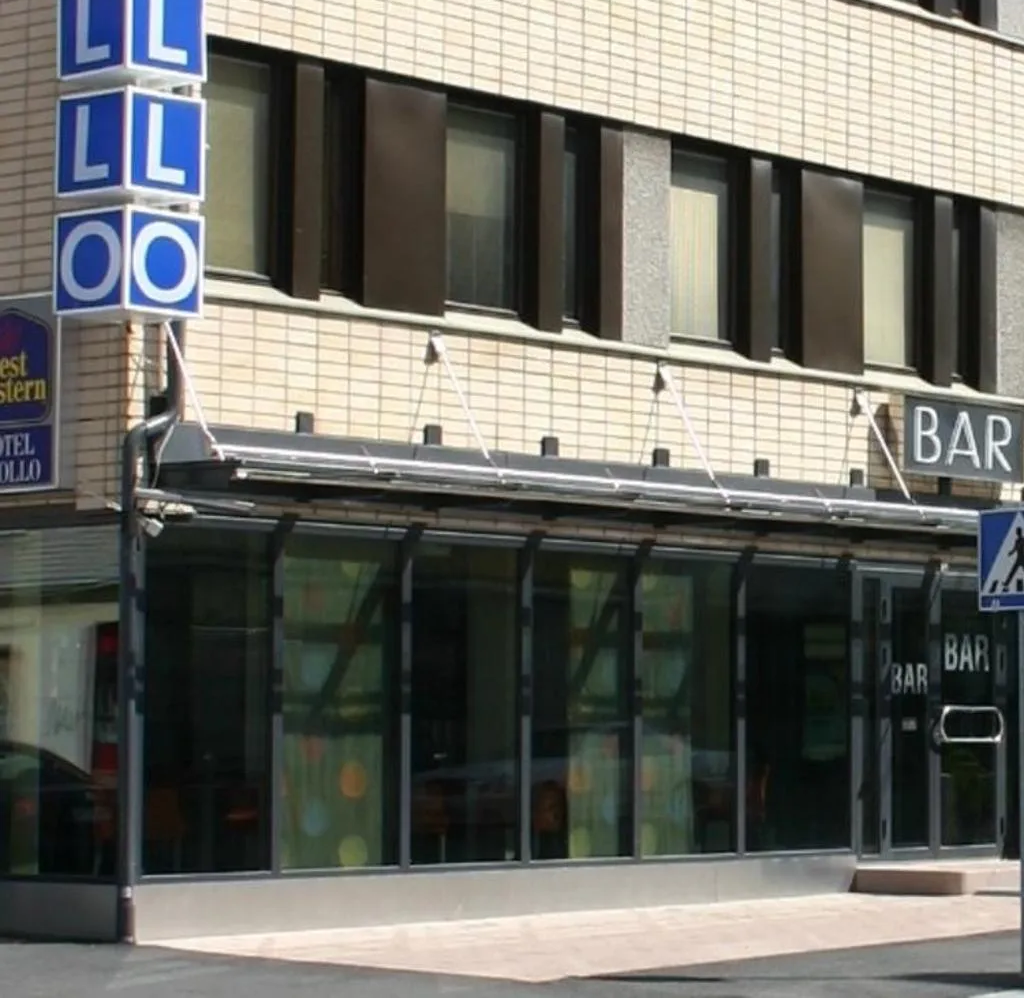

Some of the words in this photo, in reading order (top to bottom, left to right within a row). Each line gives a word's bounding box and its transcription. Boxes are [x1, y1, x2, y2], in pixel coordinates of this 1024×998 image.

[0, 351, 28, 378] est
[0, 379, 46, 403] stern
[913, 405, 1012, 473] BAR
[0, 458, 41, 483] OLLO
[944, 632, 990, 672] BAR
[890, 662, 929, 695] BAR
